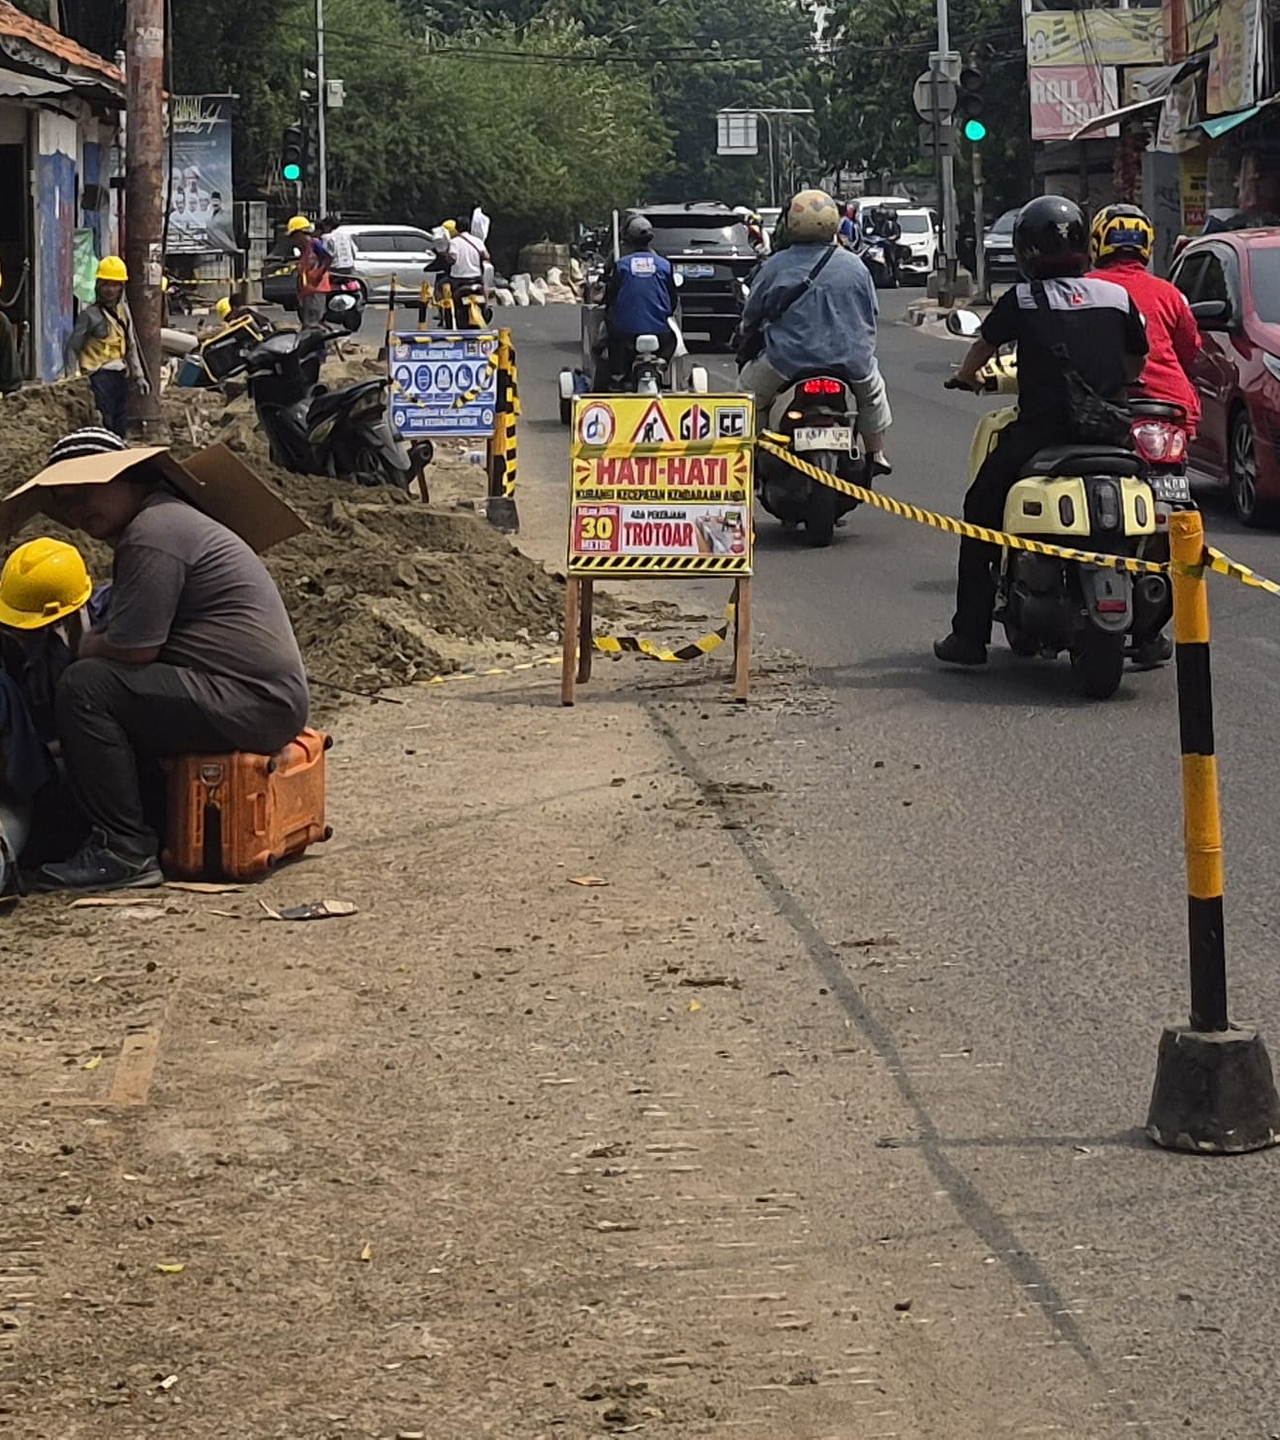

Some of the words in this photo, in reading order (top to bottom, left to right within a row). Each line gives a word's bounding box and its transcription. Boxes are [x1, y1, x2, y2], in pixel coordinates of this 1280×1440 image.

[596, 457, 728, 485] HATI-HATI
[630, 511, 645, 519] ADA
[647, 511, 686, 520] PEKERJAAN
[581, 517, 612, 539] 30
[624, 522, 693, 547] TROTOAR
